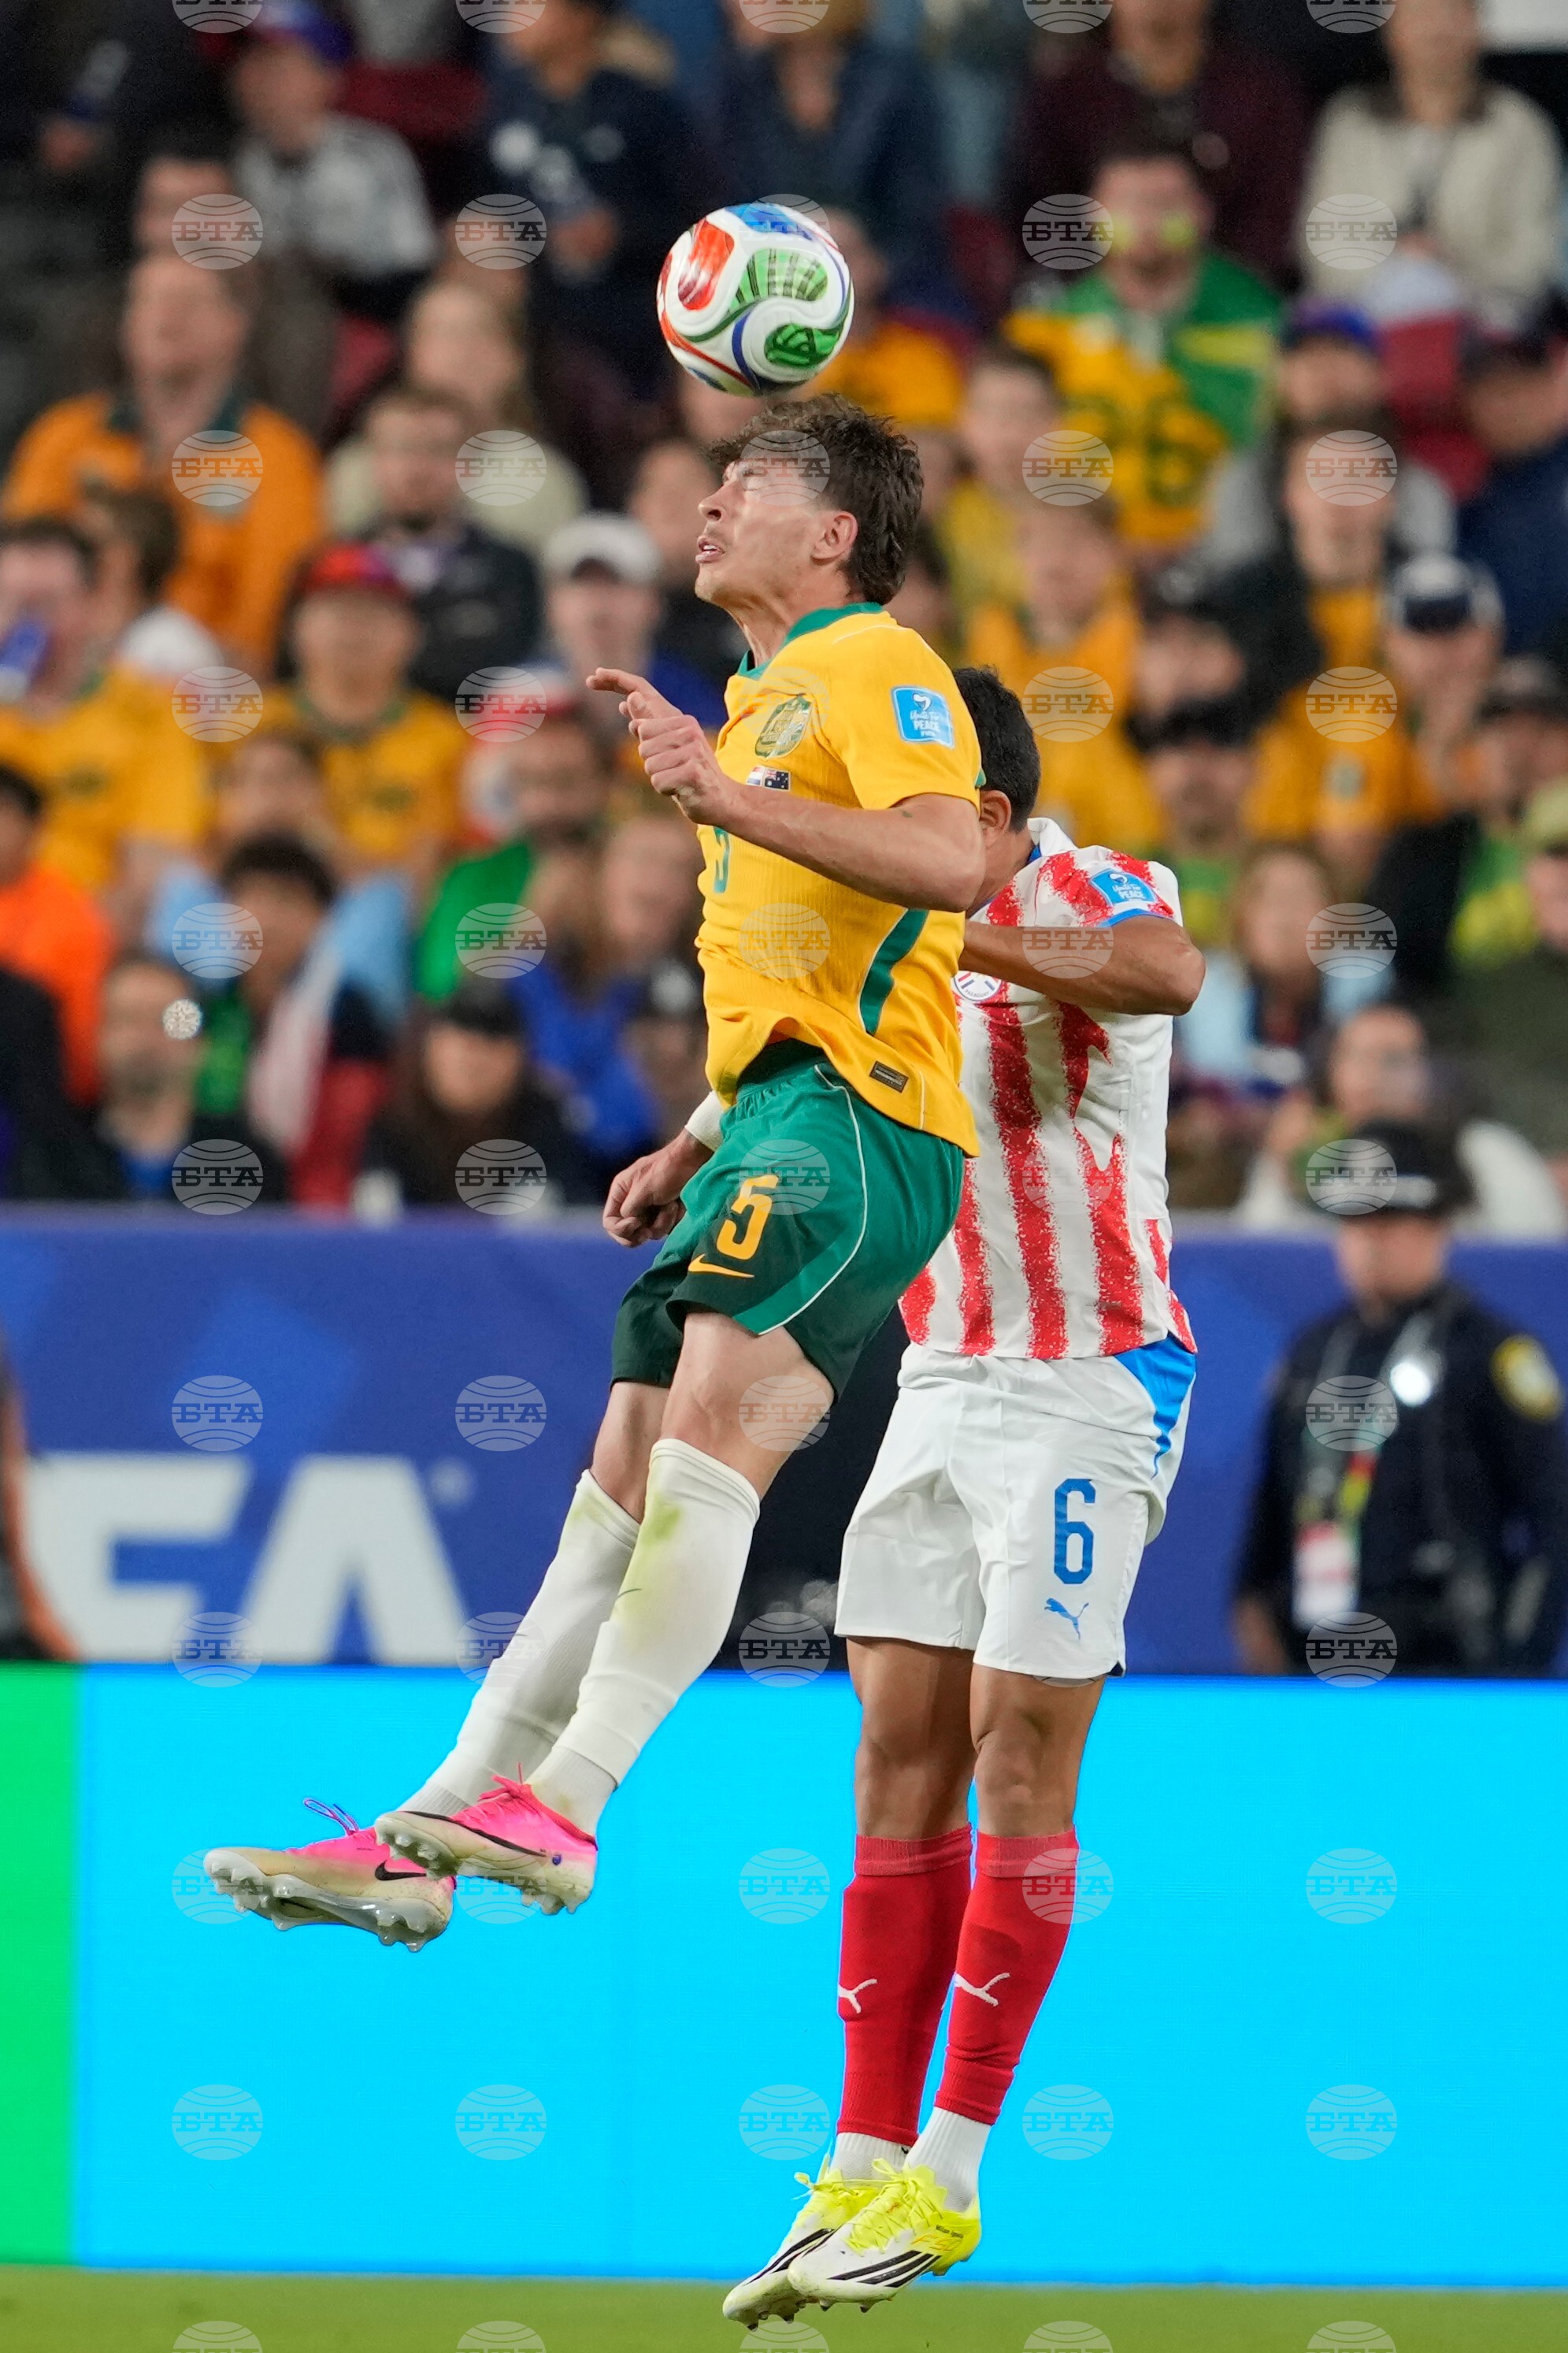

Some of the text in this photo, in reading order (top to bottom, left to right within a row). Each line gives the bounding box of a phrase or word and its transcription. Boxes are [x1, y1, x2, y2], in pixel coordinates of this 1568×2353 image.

[914, 720, 940, 731] PEACE
[1118, 889, 1147, 899] PEACE
[964, 989, 990, 998] PARAGUAY
[716, 1175, 780, 1260] 5
[1054, 1478, 1097, 1585] 6
